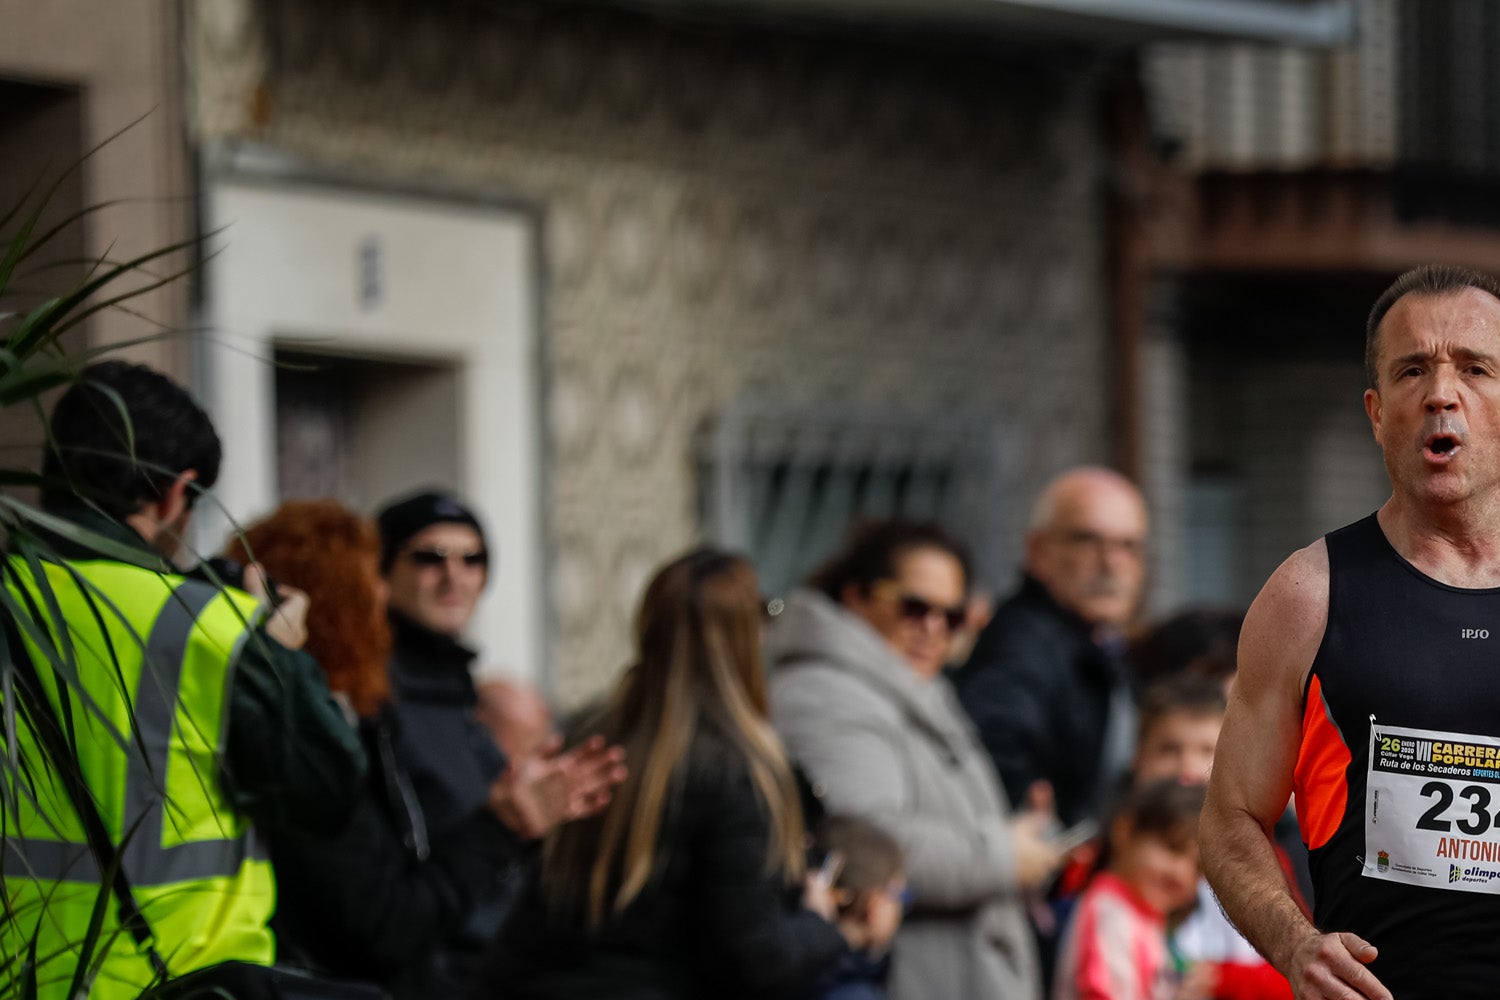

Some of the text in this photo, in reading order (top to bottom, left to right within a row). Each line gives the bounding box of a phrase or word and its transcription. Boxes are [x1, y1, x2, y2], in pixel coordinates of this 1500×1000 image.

[1381, 737, 1401, 752] 26
[1416, 741, 1432, 762] VII
[1380, 758, 1471, 776] Ruta de los Secaderos
[1462, 876, 1488, 884] deportes
